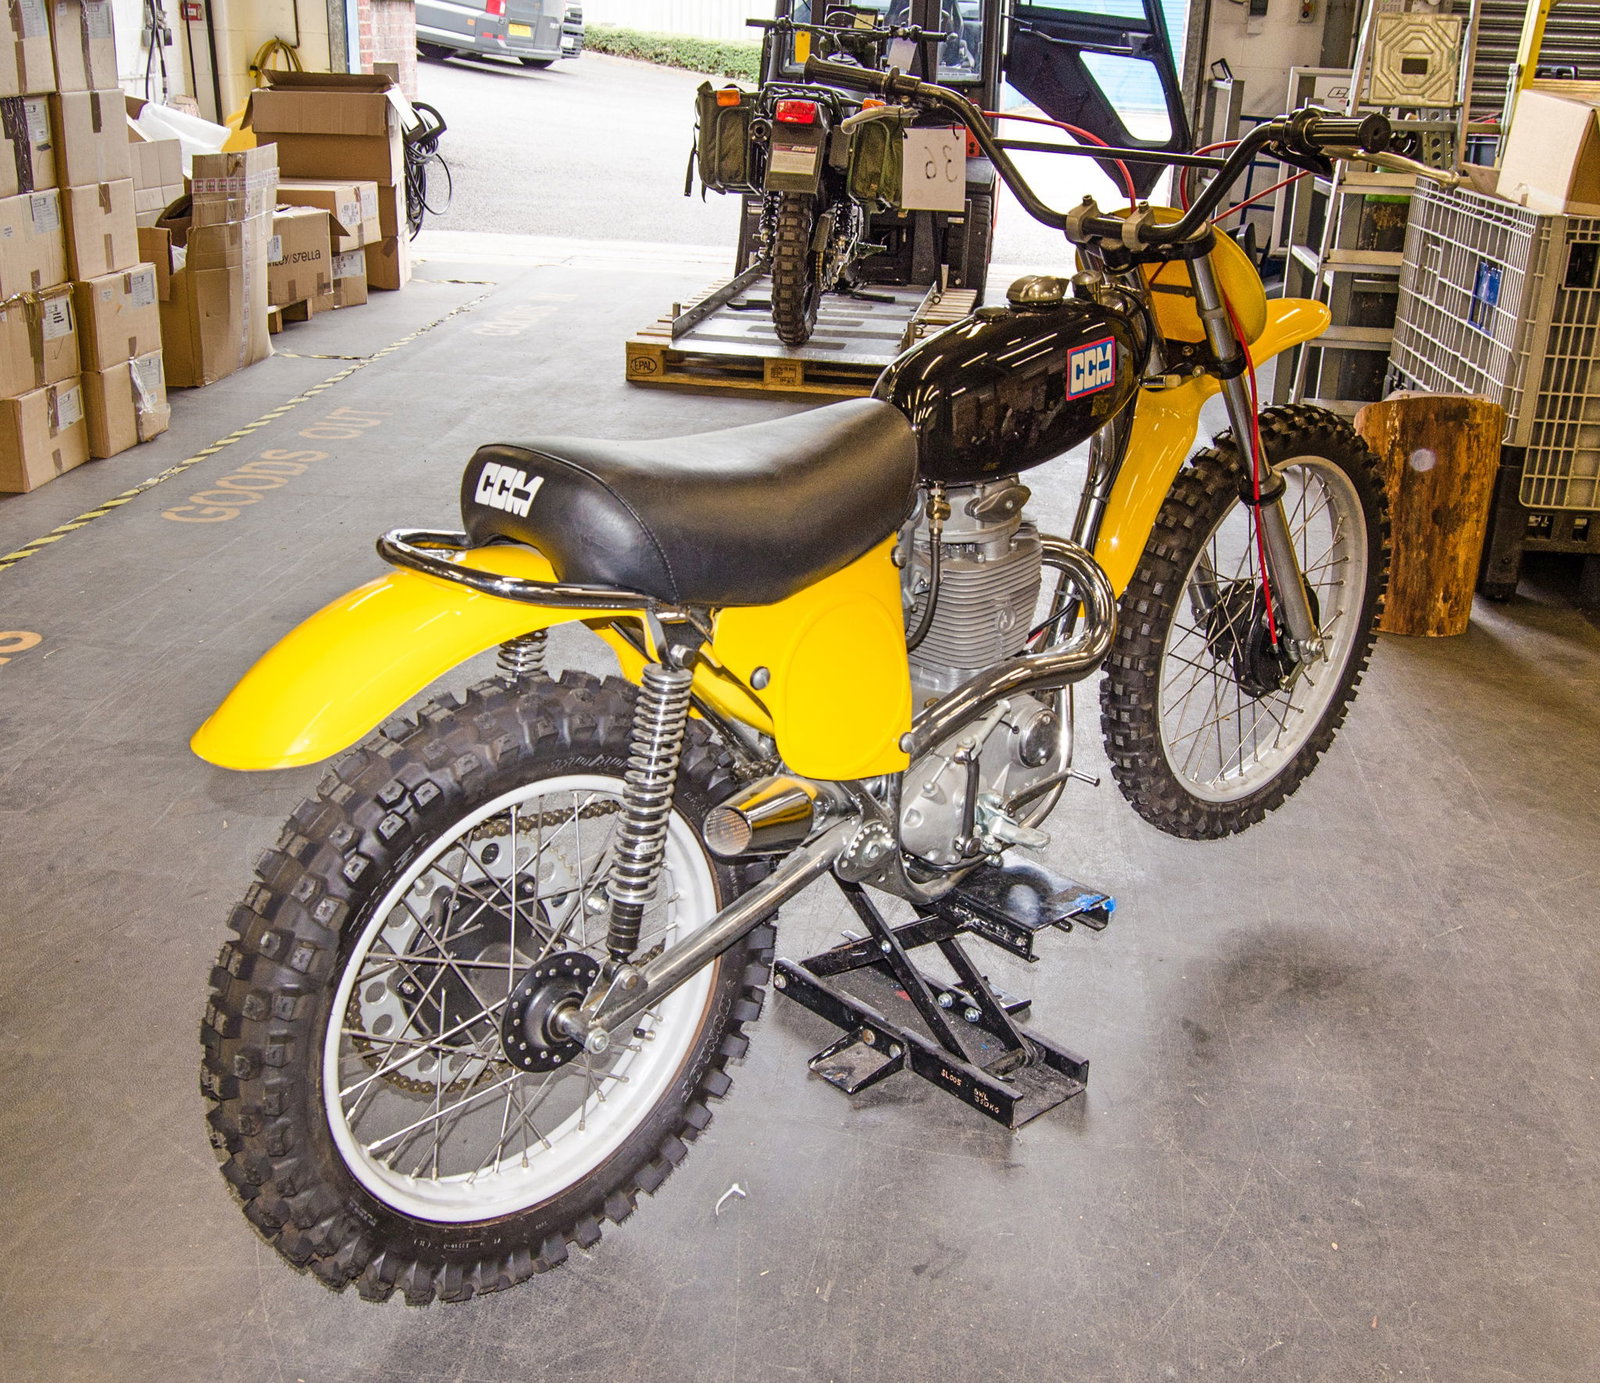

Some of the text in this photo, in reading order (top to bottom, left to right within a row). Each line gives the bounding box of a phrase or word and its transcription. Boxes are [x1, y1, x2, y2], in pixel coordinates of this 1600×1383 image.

[633, 359, 654, 371] EPAL
[1070, 343, 1113, 394] CCM
[161, 406, 393, 523] GOODS OUT
[474, 461, 545, 518] CCM
